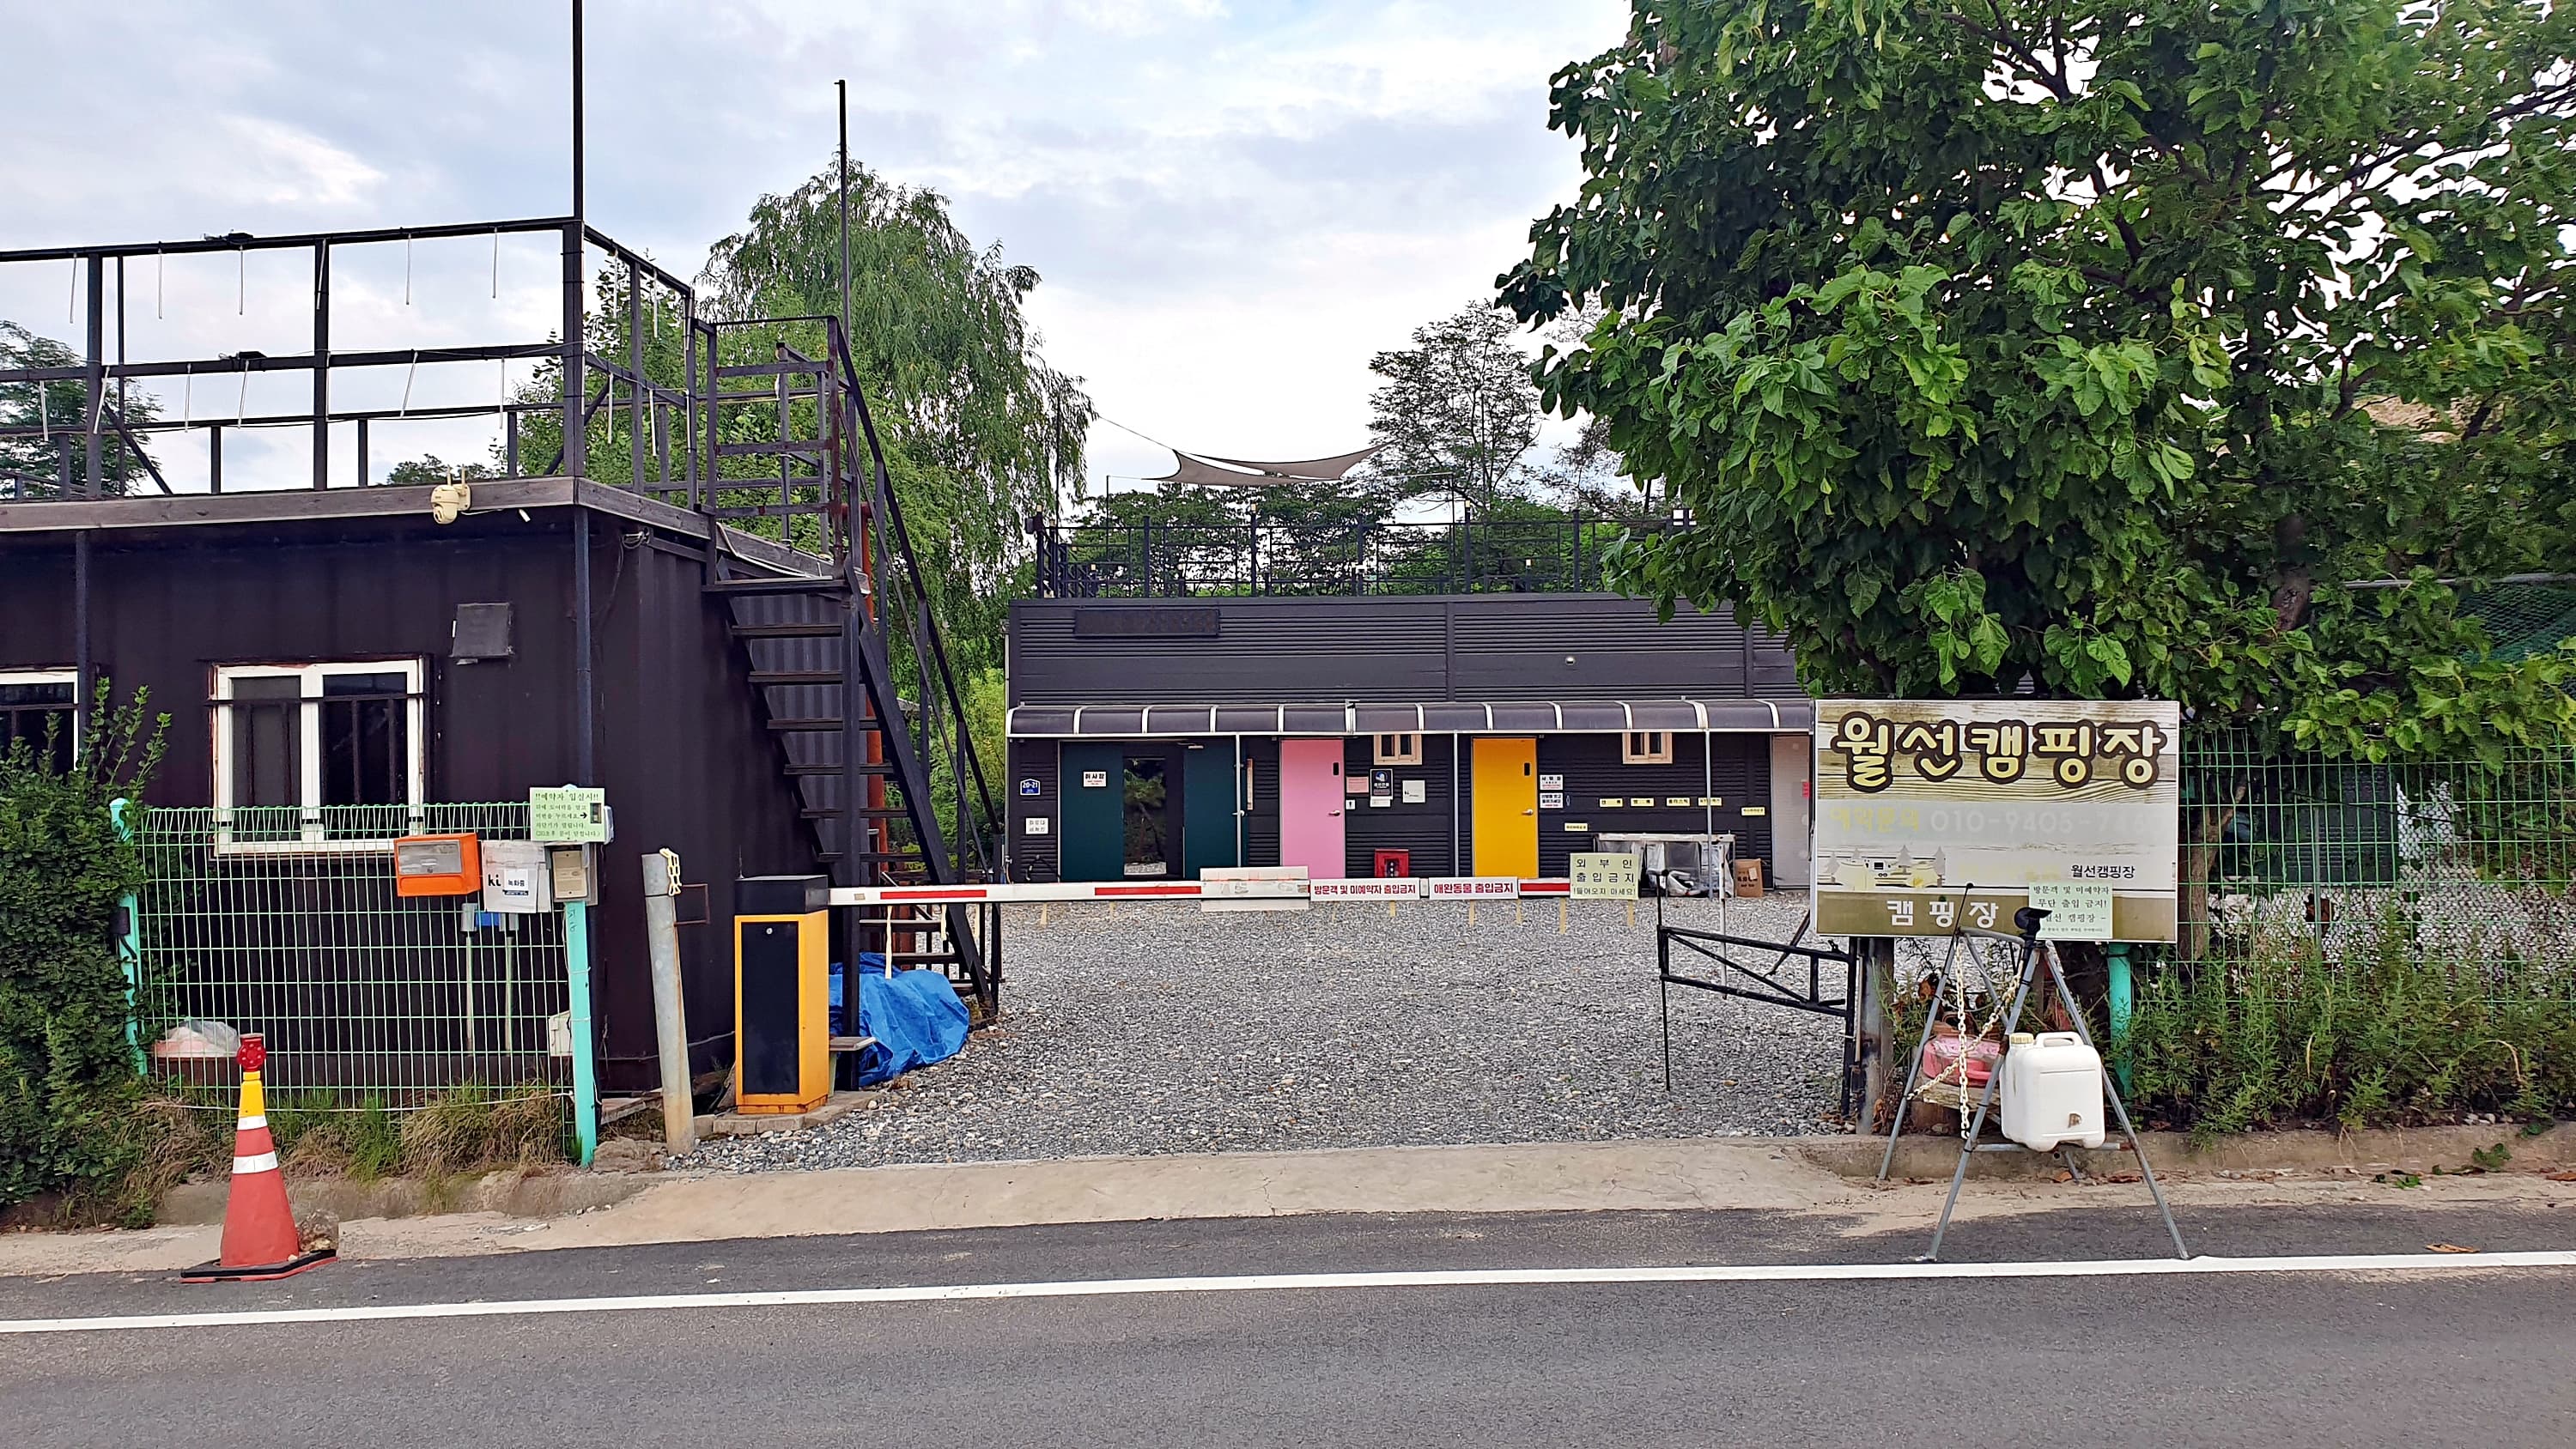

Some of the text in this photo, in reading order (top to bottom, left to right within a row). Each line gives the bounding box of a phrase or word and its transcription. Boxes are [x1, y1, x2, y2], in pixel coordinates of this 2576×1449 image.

[1831, 711, 2167, 793] 월선캠핑장
[1577, 872, 1634, 882] 출입금지
[2070, 864, 2136, 879] 월선캠핑장
[1314, 884, 1416, 894] 방문객 및 미예약자 출입금지
[1434, 882, 1514, 894] 애완동물 출입금지
[2033, 886, 2058, 894] 방문객
